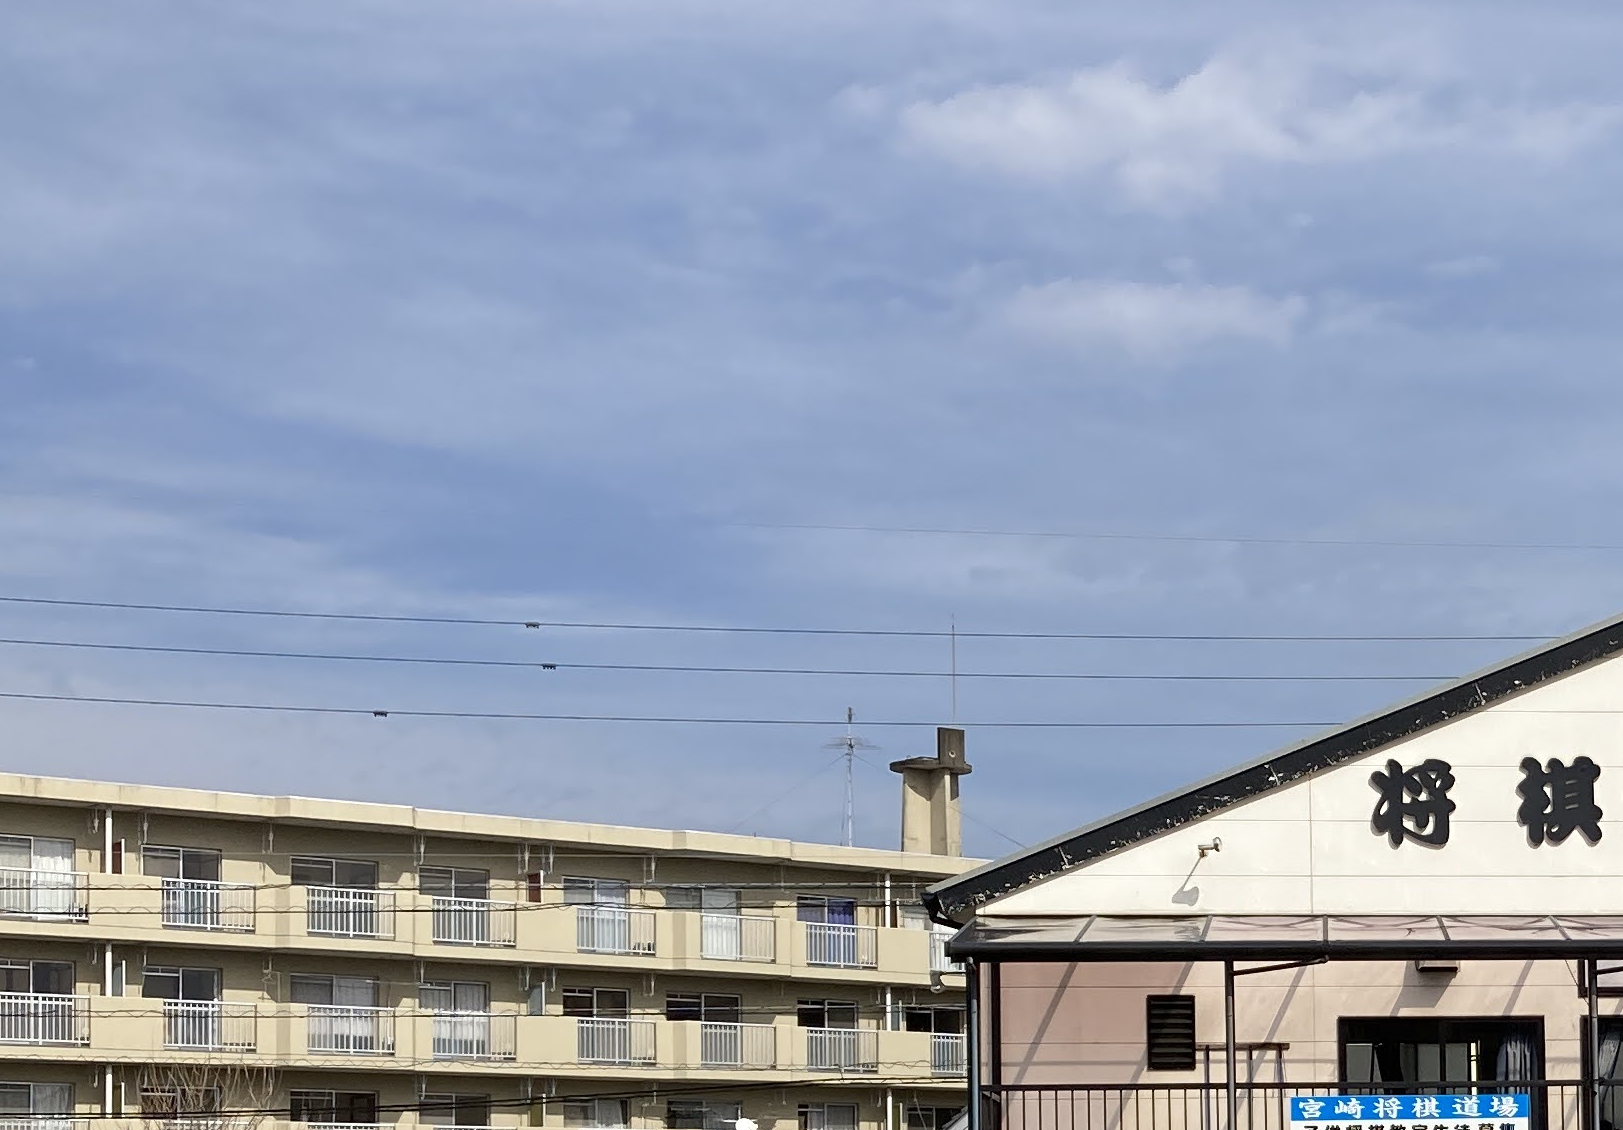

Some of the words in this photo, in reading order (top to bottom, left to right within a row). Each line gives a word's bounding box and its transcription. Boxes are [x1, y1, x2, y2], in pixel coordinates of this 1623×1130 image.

[1370, 756, 1602, 848] 将棋
[1298, 1095, 1520, 1119] 宮崎将棋道場
